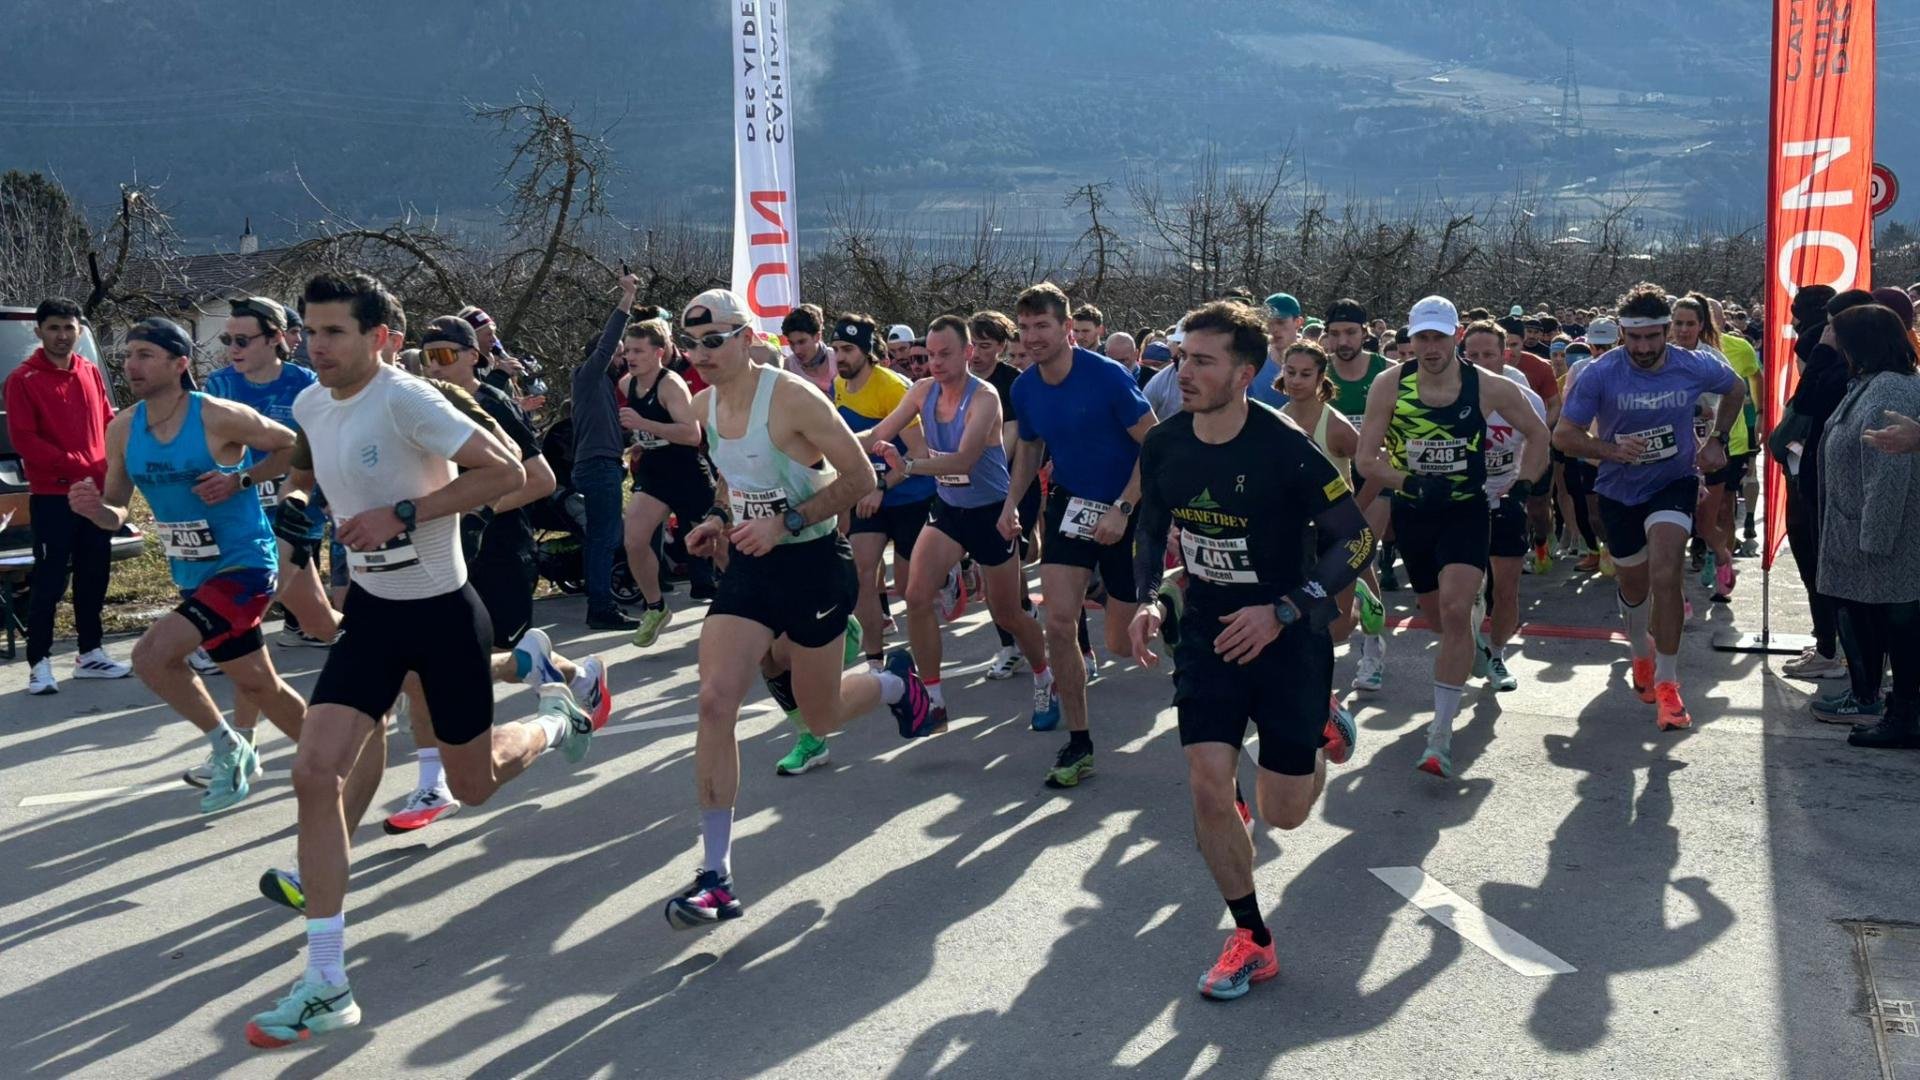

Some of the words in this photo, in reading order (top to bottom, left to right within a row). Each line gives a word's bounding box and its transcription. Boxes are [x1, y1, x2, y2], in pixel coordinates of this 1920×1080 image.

[1426, 449, 1455, 462] 348
[747, 502, 776, 519] 425
[1080, 509, 1105, 527] 38
[174, 531, 202, 546] 340
[1202, 548, 1235, 570] 441
